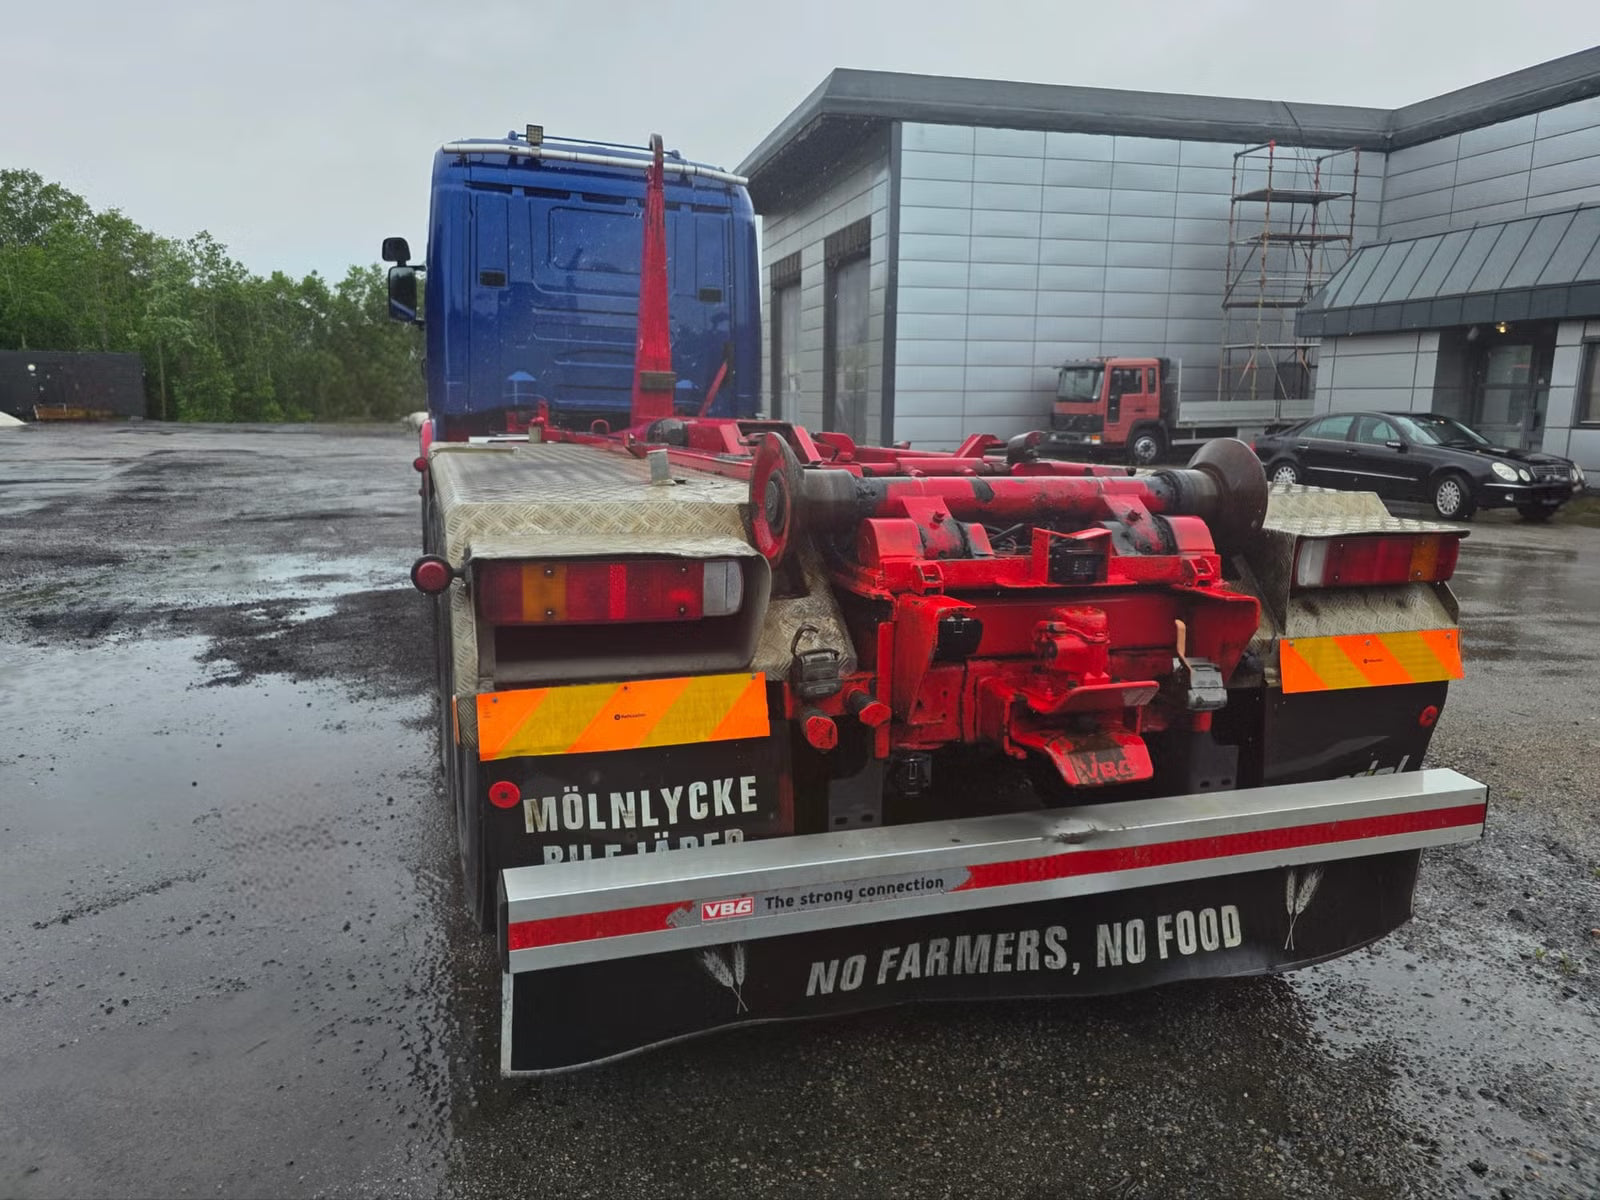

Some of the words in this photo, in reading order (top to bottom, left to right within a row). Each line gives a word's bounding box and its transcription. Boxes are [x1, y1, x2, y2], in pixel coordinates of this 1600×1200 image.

[523, 775, 758, 834] MÖLNLYCKE
[704, 900, 752, 918] VBG
[765, 896, 794, 910] The
[800, 889, 853, 905] strong
[858, 877, 944, 898] connection
[805, 953, 867, 997] NO
[877, 924, 1081, 986] FARMERS,
[1095, 918, 1147, 968] NO
[1157, 904, 1243, 961] FOOD
